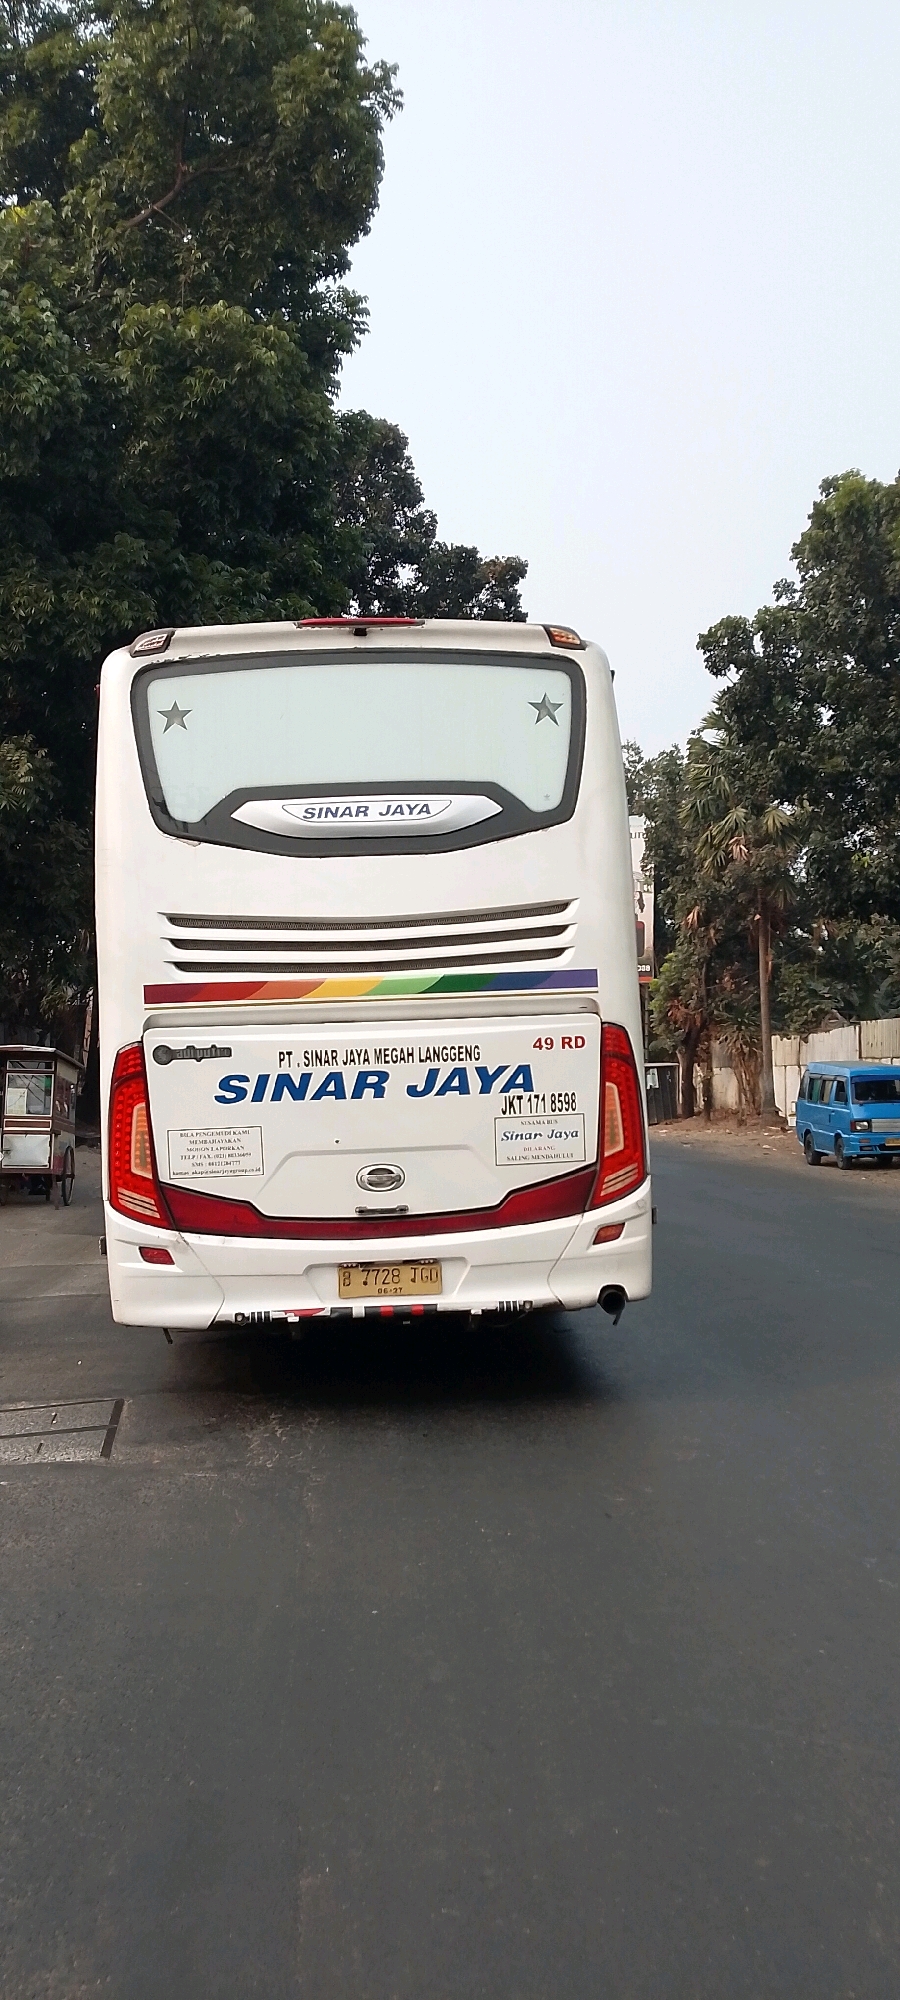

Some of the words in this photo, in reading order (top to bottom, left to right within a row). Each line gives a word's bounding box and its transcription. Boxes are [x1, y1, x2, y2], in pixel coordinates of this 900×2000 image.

[303, 805, 370, 820] SINAR
[378, 803, 432, 817] JAYA
[532, 1036, 554, 1051] 49
[561, 1035, 586, 1050] RD
[303, 1049, 338, 1068] SINAR
[342, 1048, 371, 1066] JAYA
[374, 1047, 415, 1065] MEGAH
[418, 1045, 481, 1063] LANGGENG
[214, 1070, 390, 1104] SINAR
[406, 1064, 535, 1098] JAYA
[501, 1094, 523, 1115] JKT
[527, 1093, 546, 1114] 171
[550, 1091, 577, 1113] 8598
[501, 1130, 543, 1142] Sinar
[547, 1129, 579, 1140] Jaya
[342, 1270, 351, 1287] B
[361, 1268, 401, 1286] 7728
